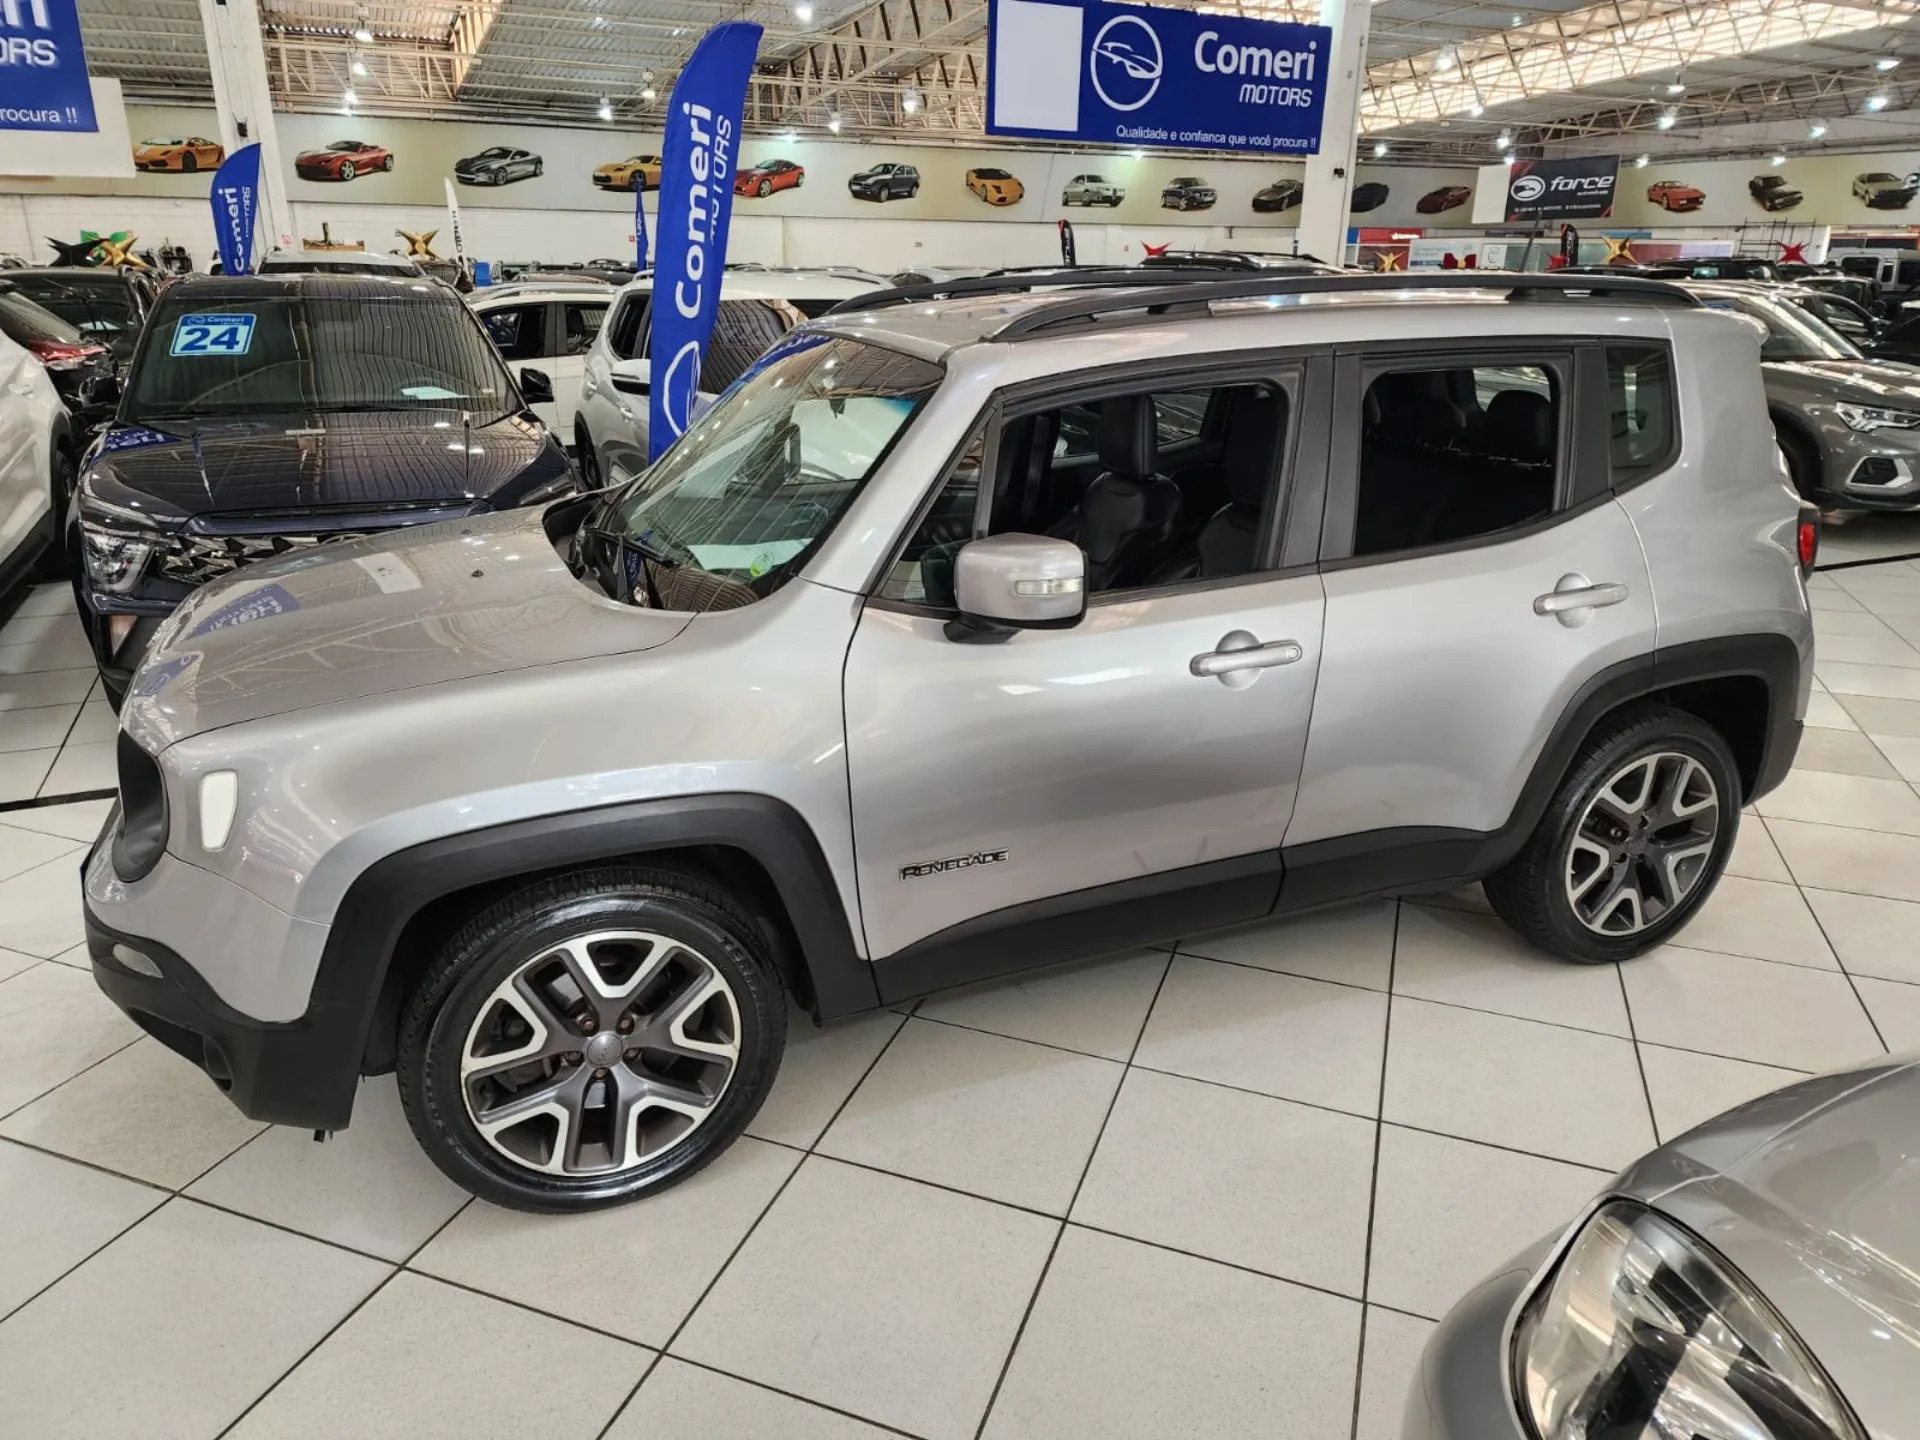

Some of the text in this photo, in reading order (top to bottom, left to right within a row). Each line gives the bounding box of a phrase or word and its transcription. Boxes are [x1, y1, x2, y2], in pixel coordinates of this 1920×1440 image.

[1194, 30, 1317, 81] Comeri
[1238, 83, 1313, 108] MOTORS
[1116, 125, 1168, 140] Qualidade
[1170, 130, 1177, 141] e
[1228, 133, 1247, 147] que
[1249, 134, 1271, 146] você
[1273, 136, 1308, 149] procura
[1549, 175, 1615, 191] force
[675, 101, 712, 319] Comeri
[217, 187, 245, 272] Comeri
[180, 326, 240, 351] 24
[898, 847, 1009, 882] RENEGADE
